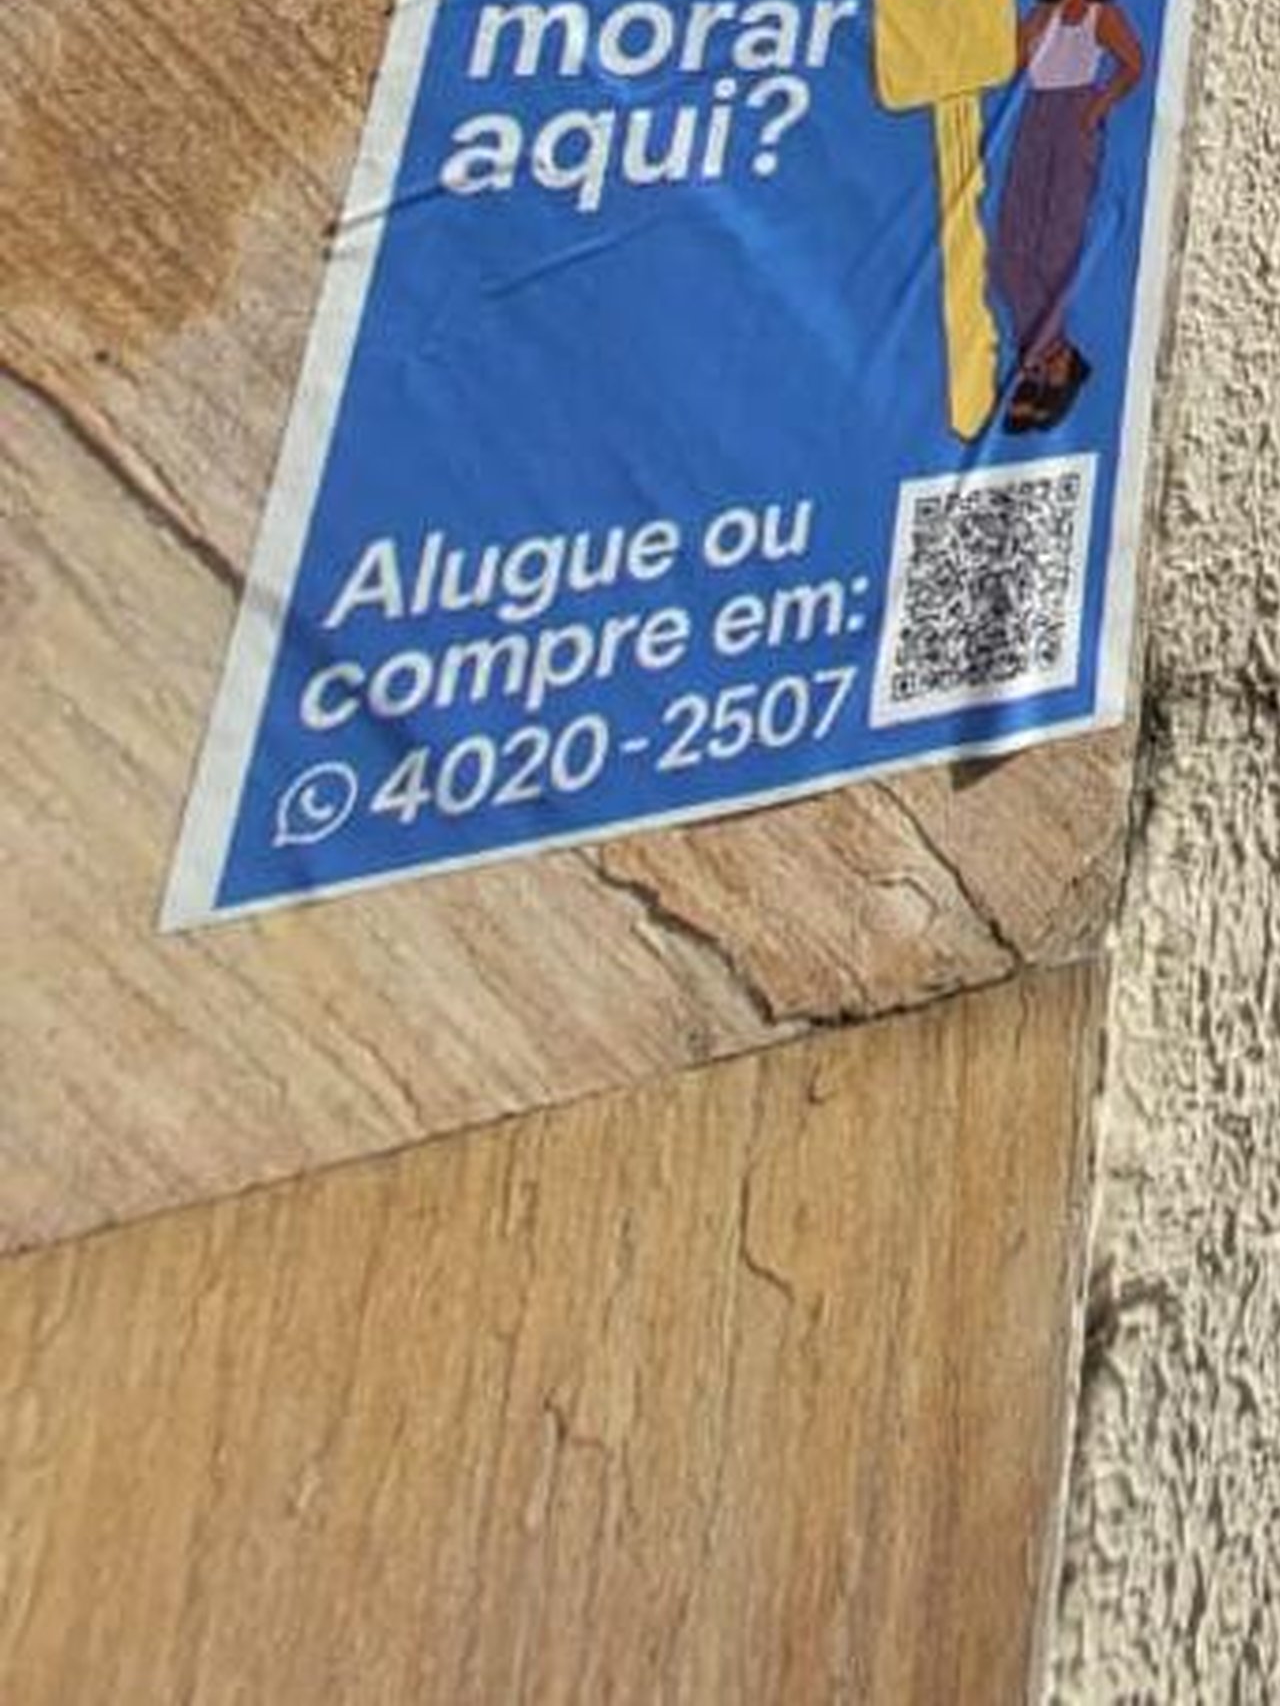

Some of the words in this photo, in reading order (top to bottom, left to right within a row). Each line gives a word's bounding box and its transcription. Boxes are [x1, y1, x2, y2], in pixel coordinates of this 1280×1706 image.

[440, 75, 811, 212] aqui?
[322, 518, 680, 629] Alugue
[703, 500, 812, 569] ou
[300, 603, 691, 730] compre
[714, 576, 869, 656] em:
[369, 666, 858, 824] 4020-2507
